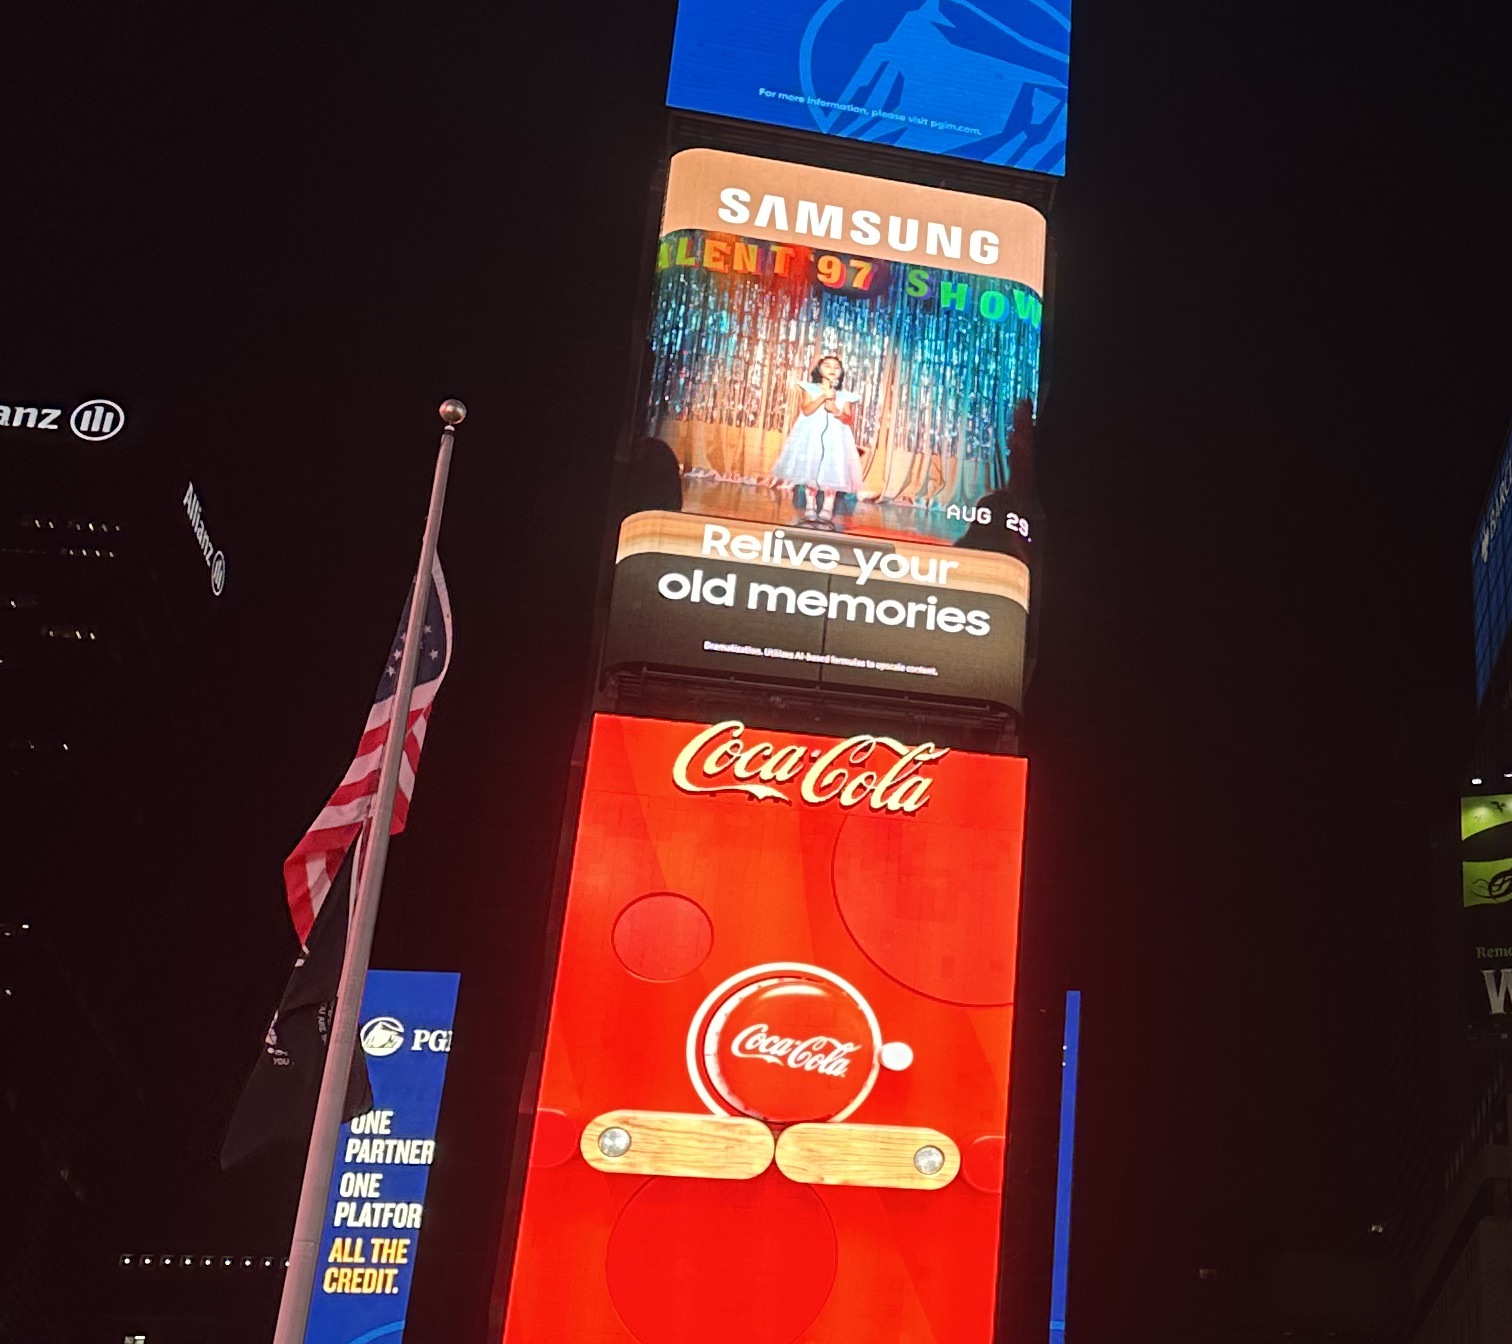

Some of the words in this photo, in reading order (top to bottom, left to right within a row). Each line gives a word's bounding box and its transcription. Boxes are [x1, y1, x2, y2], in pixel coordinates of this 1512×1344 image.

[758, 87, 776, 97] For
[717, 187, 1001, 265] SAMSUNG
[946, 504, 992, 525] AUG
[700, 524, 841, 570] Relive
[856, 547, 960, 586] your
[657, 570, 737, 608] old
[747, 582, 991, 637] memories
[351, 1110, 394, 1135] ONE
[345, 1138, 436, 1165] PARTNER
[339, 1172, 383, 1198] ONE
[328, 1237, 366, 1263] ALL
[370, 1238, 411, 1264] THE
[322, 1267, 399, 1294] CREDIT.
